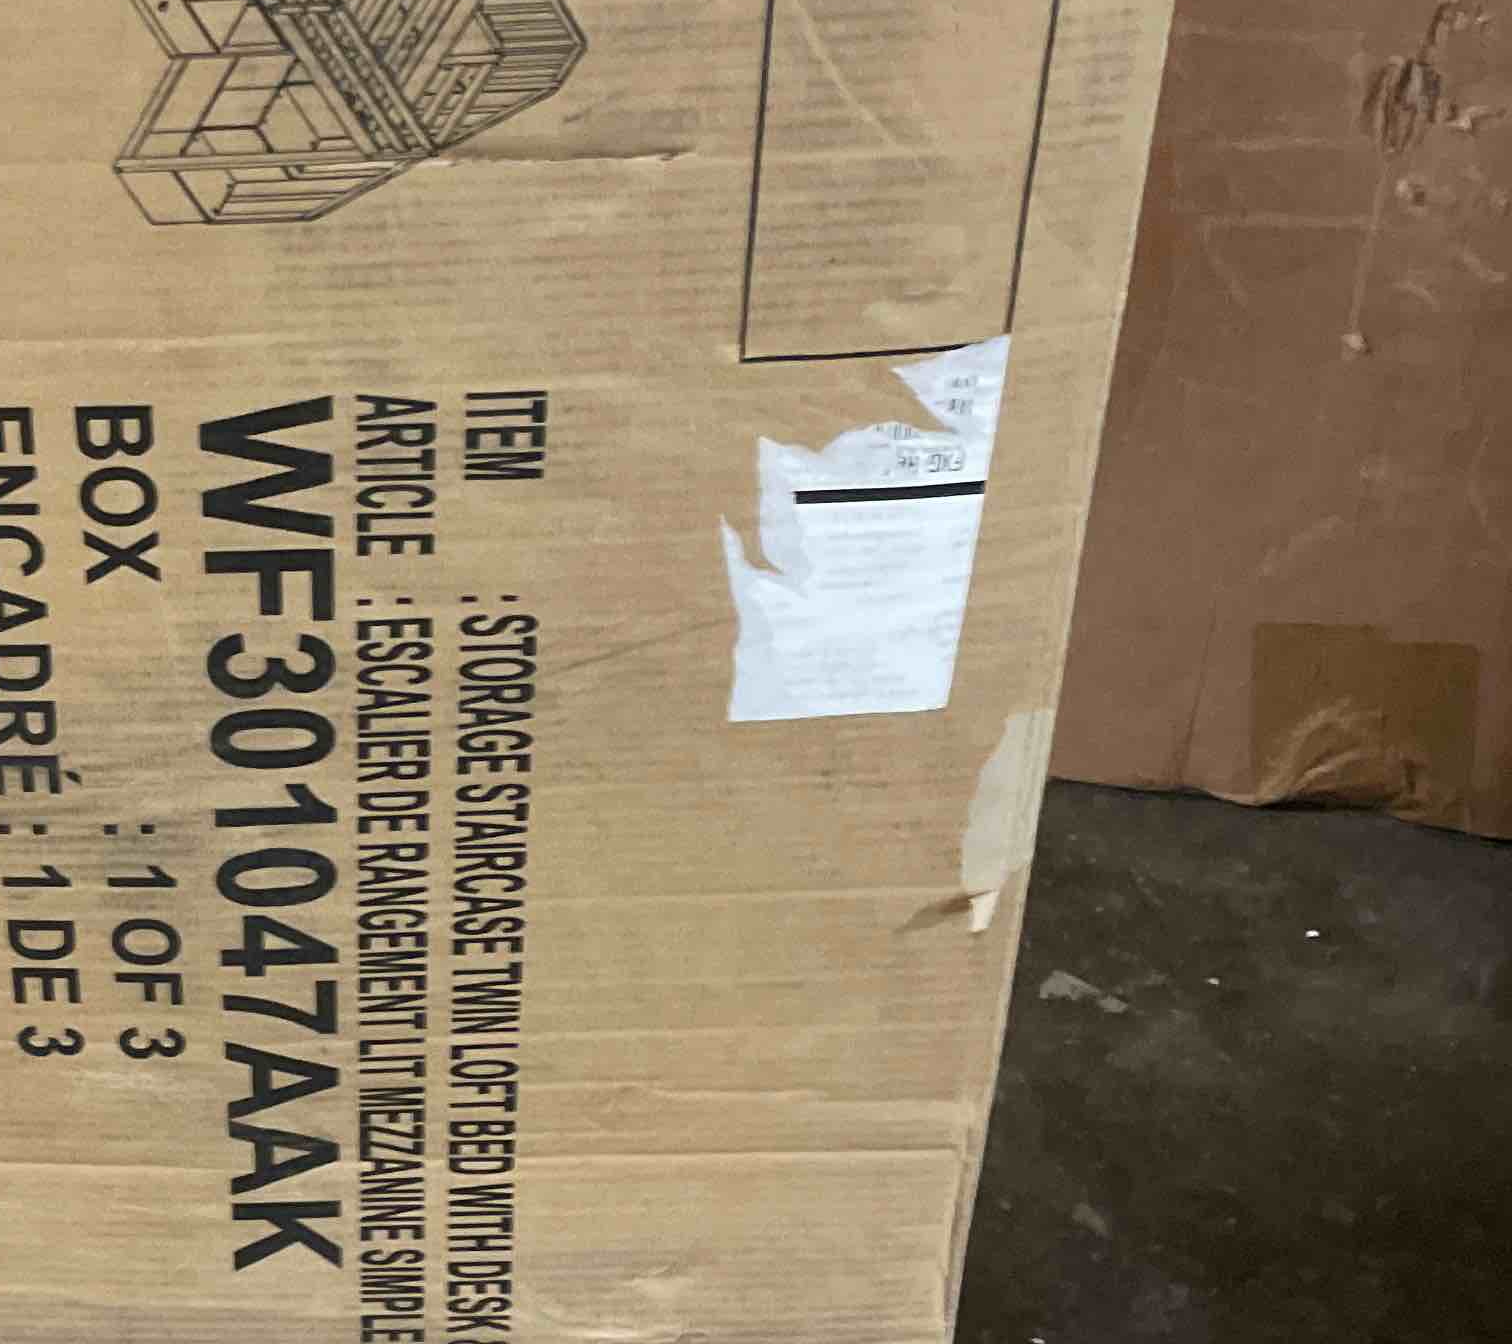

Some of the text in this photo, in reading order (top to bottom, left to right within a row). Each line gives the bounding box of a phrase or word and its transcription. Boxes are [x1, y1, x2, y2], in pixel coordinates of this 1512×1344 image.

[355, 394, 437, 556] ARTICLE
[463, 390, 549, 481] ITEM
[74, 405, 161, 583] BOX
[355, 618, 433, 781] ESCALIER
[454, 614, 538, 775] STORAGE
[199, 395, 342, 1272] WF301047AAK
[356, 791, 429, 832] DE
[1, 864, 71, 888] 1
[106, 864, 177, 889] 1
[451, 784, 531, 955] STAIRCASE
[6, 920, 80, 1005] DE
[110, 918, 183, 1006] OF
[356, 844, 427, 1029] RANGEMENT
[449, 961, 523, 1034] TWIN
[17, 1026, 84, 1057] 3
[118, 1026, 185, 1059] 3
[357, 1038, 426, 1077] LIT
[446, 1045, 517, 1112] LOFT
[359, 1086, 426, 1241] MEZZANINE
[445, 1120, 514, 1175] BED
[445, 1183, 511, 1252] WITH
[359, 1249, 424, 1343] SIMPLE
[444, 1261, 509, 1336] DESK
